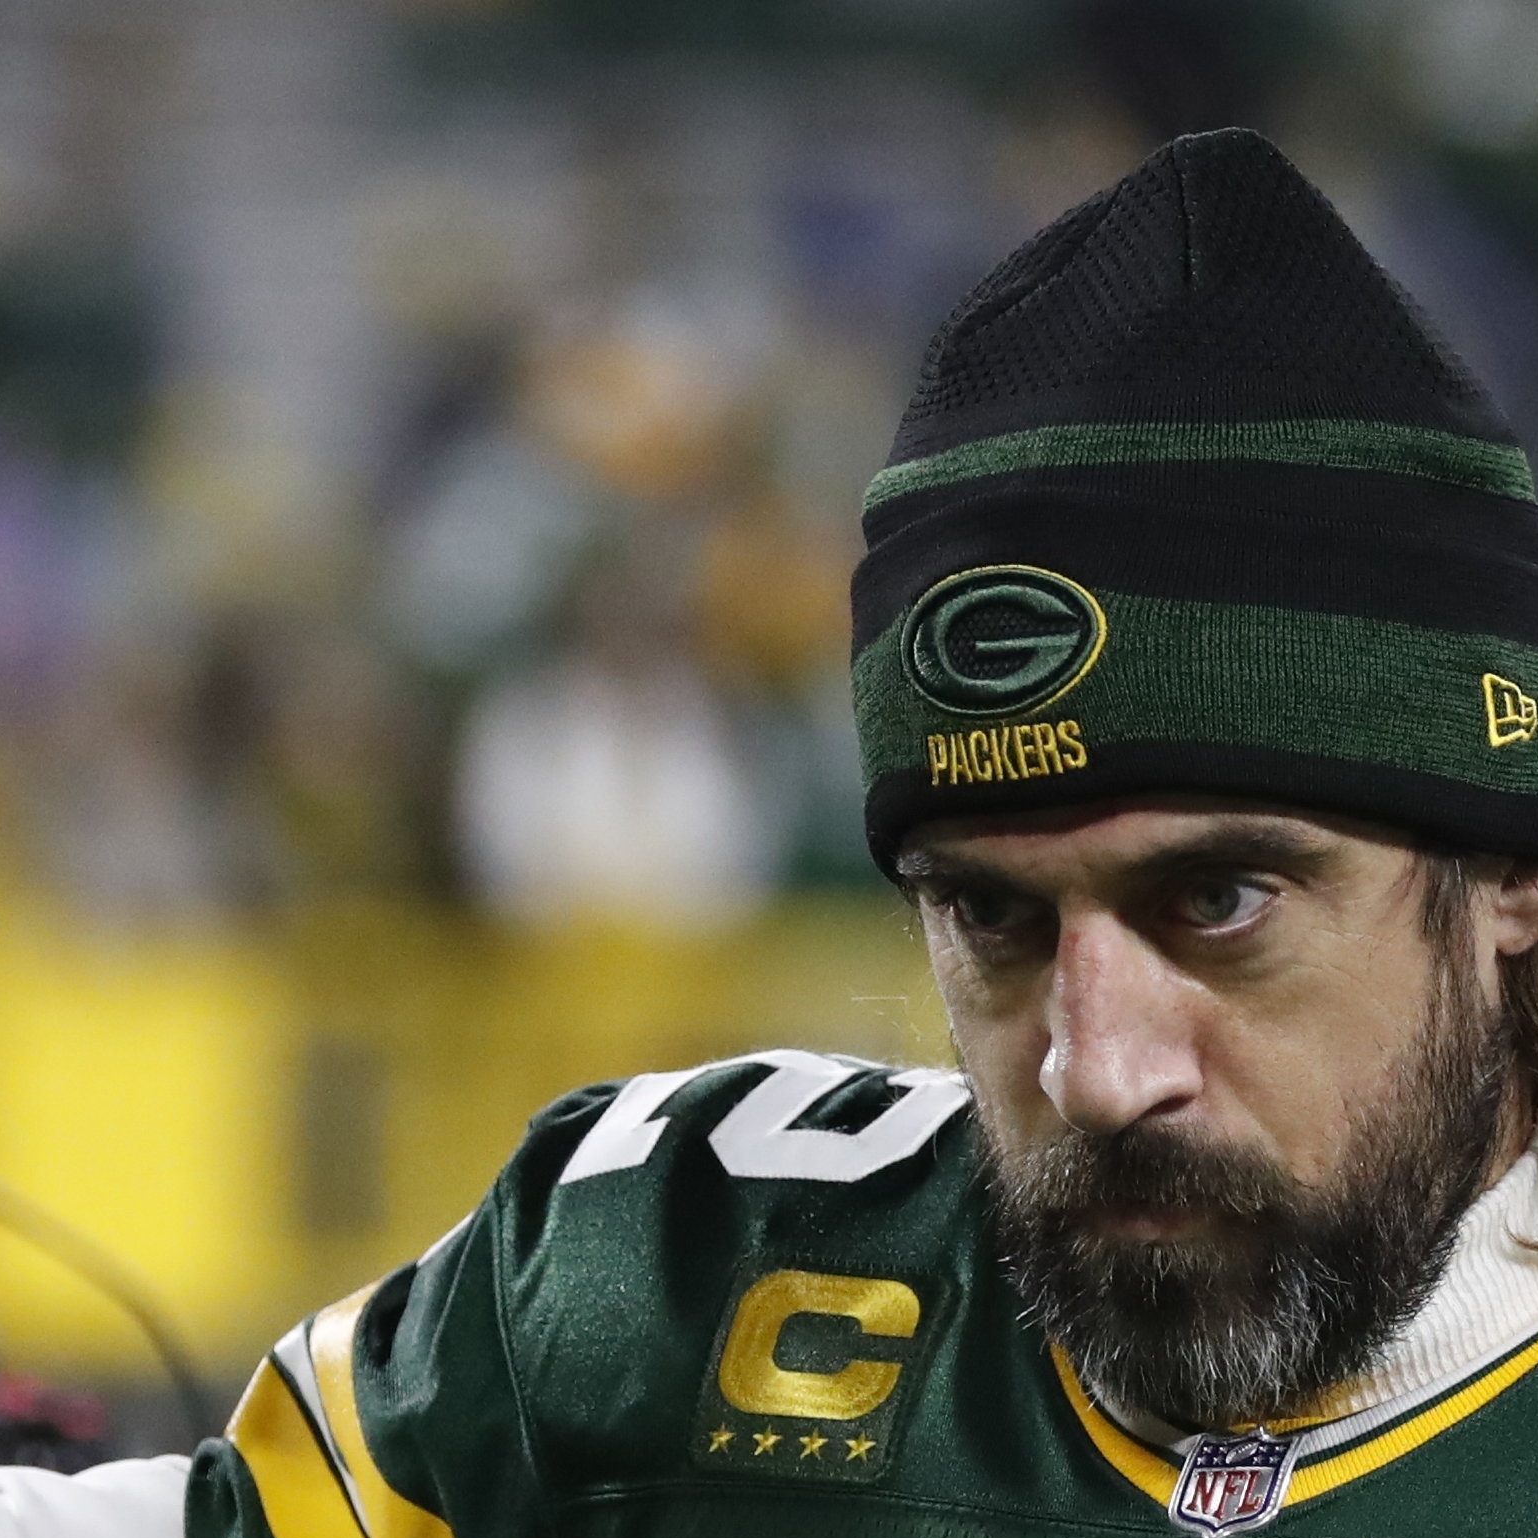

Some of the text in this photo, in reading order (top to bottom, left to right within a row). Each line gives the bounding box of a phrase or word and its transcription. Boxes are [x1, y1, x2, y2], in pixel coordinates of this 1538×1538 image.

[927, 719, 1087, 786] PACKERS
[719, 1269, 921, 1420] C
[1186, 1470, 1263, 1520] NFL
